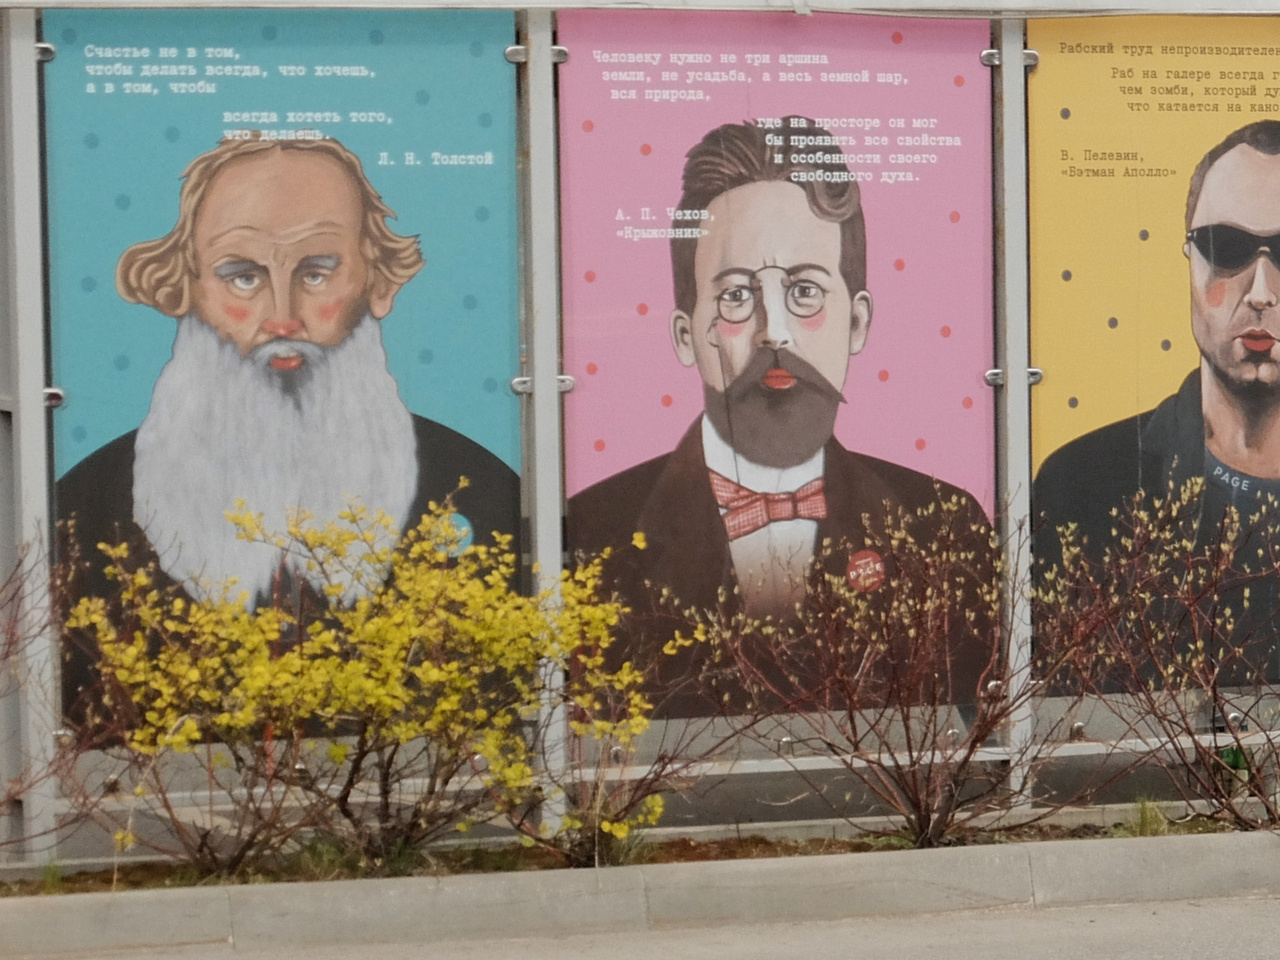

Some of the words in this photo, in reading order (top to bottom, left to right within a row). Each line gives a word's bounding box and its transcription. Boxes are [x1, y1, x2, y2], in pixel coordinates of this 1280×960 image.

[84, 44, 150, 59] Счастье
[159, 46, 179, 59] не
[187, 46, 197, 59] в
[1059, 42, 1114, 55] Рабский
[1121, 44, 1154, 57] труд
[593, 50, 662, 66] Человеку
[669, 52, 712, 65] нужно
[720, 52, 737, 64] не
[745, 52, 771, 66] три
[779, 52, 829, 66] аршина
[85, 63, 132, 77] чтобы
[141, 64, 197, 77] делать
[279, 64, 306, 77] что
[661, 69, 679, 82] не
[762, 70, 771, 82] а
[779, 70, 812, 83] весь
[820, 69, 870, 83] земной
[1111, 67, 1134, 79] Раб
[1142, 70, 1158, 79] на
[1165, 70, 1211, 81] галере
[1219, 70, 1265, 81] всегда
[86, 82, 96, 94] а
[105, 82, 115, 94] в
[169, 80, 216, 94] чтобы
[610, 88, 637, 100] вся
[1119, 85, 1143, 96] чем
[1204, 85, 1257, 98] который
[1127, 102, 1150, 112] что
[1157, 102, 1220, 112] катается
[1227, 102, 1243, 112] на
[223, 110, 278, 124] всегда
[287, 110, 341, 123] хотеть
[757, 115, 783, 129] где
[790, 116, 808, 128] на
[815, 116, 881, 129] просторе
[888, 116, 906, 128] он
[913, 116, 938, 128] мог
[223, 128, 252, 140] что
[765, 133, 783, 146] бы
[790, 134, 856, 147] проявить
[864, 134, 889, 146] все
[896, 133, 962, 146] свойства
[431, 151, 494, 166] Толстой
[773, 152, 783, 164] и
[791, 151, 882, 164] особенности
[889, 152, 938, 164] своего
[791, 169, 873, 183] свободного
[1213, 466, 1250, 491] PAGE
